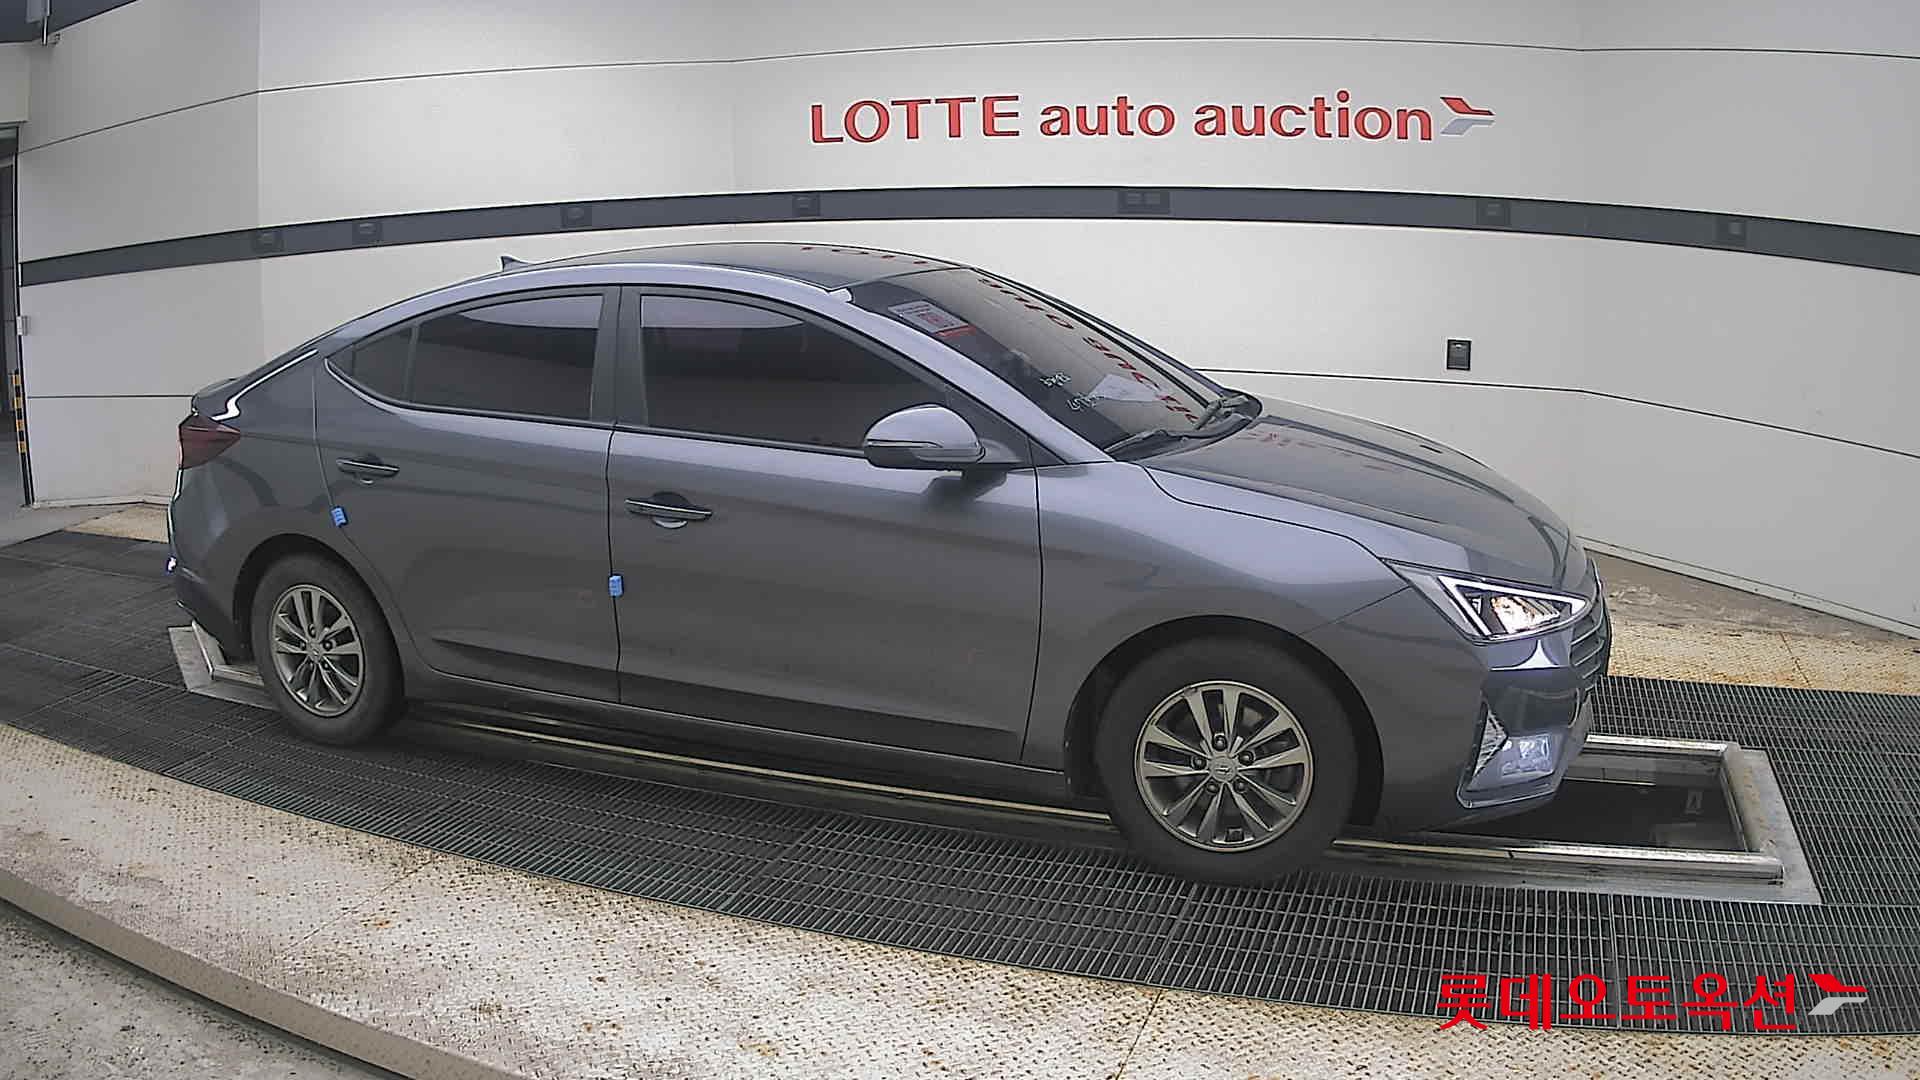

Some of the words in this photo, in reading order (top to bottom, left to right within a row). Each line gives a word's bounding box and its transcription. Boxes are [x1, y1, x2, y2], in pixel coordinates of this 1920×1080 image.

[811, 95, 1019, 143] LOTTE
[1040, 96, 1176, 136] auto
[1194, 90, 1433, 141] auction
